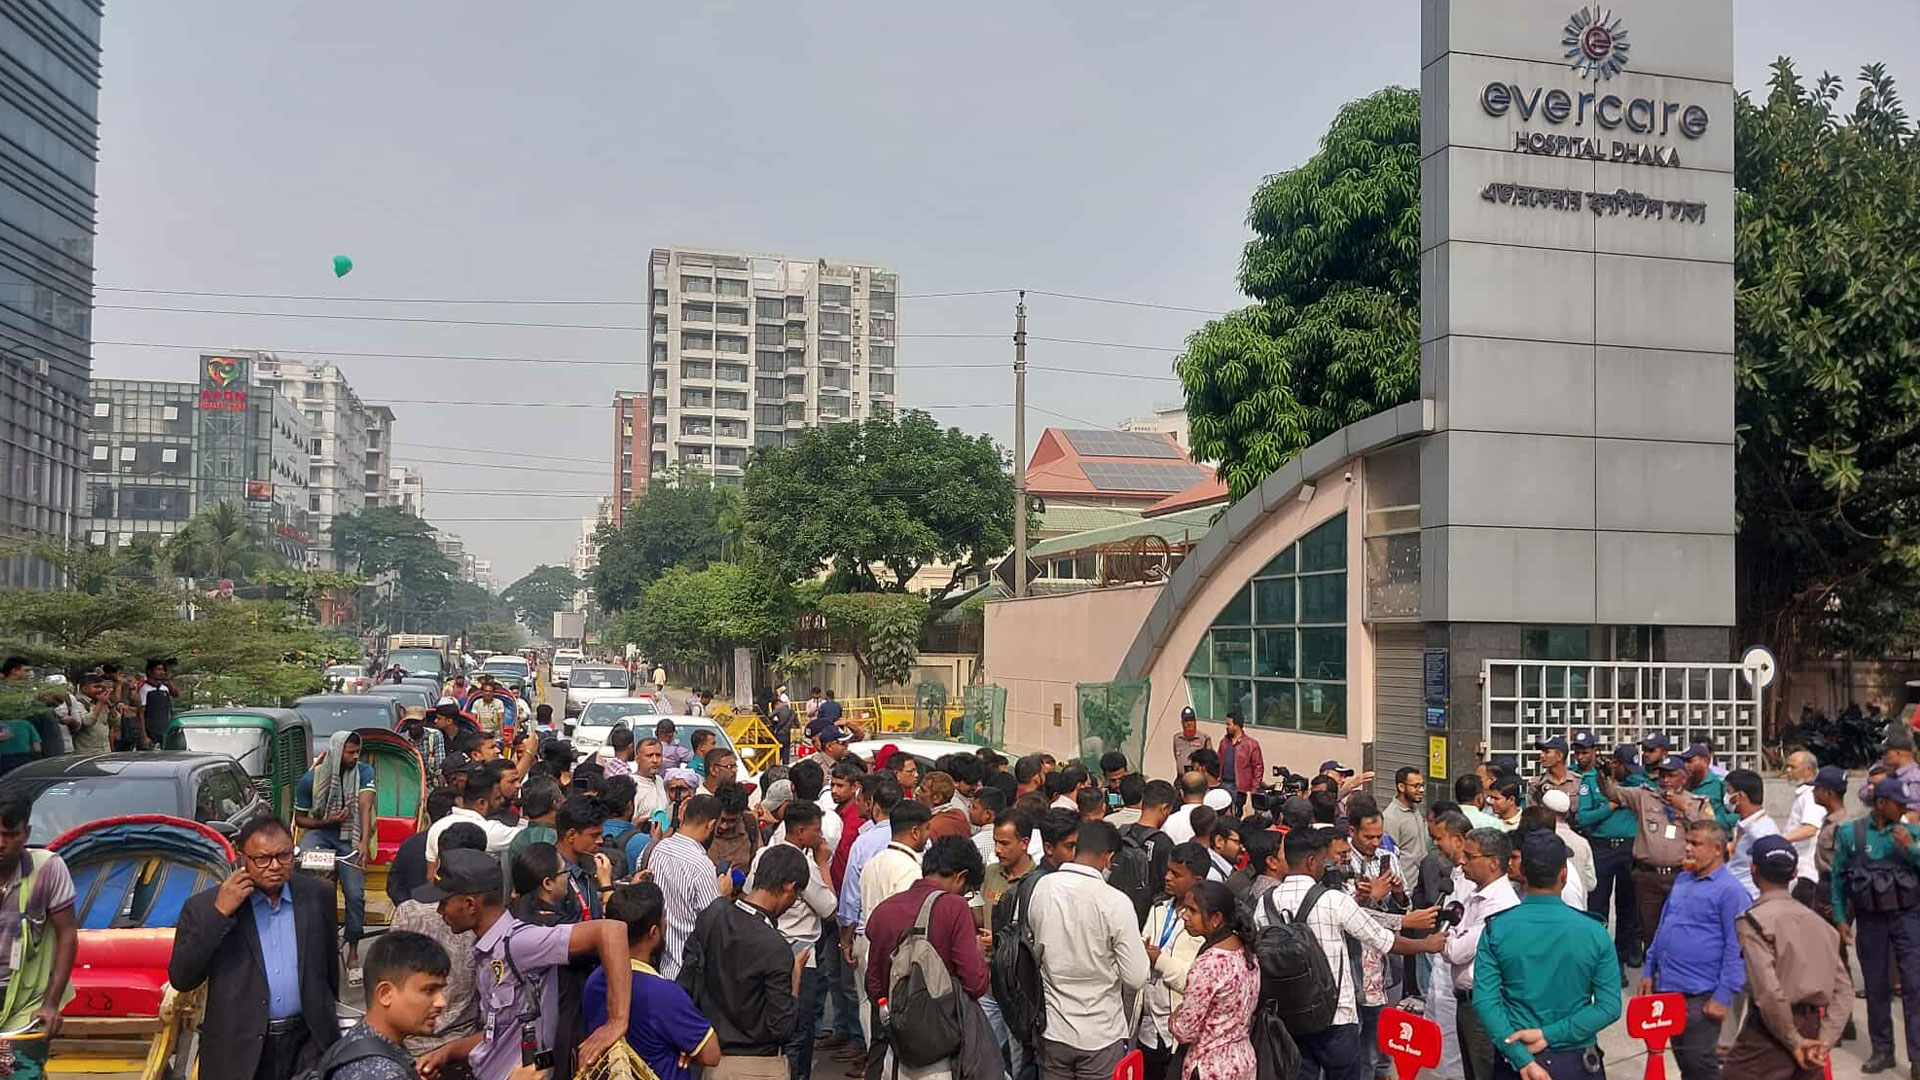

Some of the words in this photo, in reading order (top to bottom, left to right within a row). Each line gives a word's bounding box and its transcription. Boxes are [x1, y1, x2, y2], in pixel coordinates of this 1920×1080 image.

[1481, 81, 1708, 139] evercare
[1513, 131, 1606, 160] HOSPITAL
[1611, 141, 1681, 167] DHAKA
